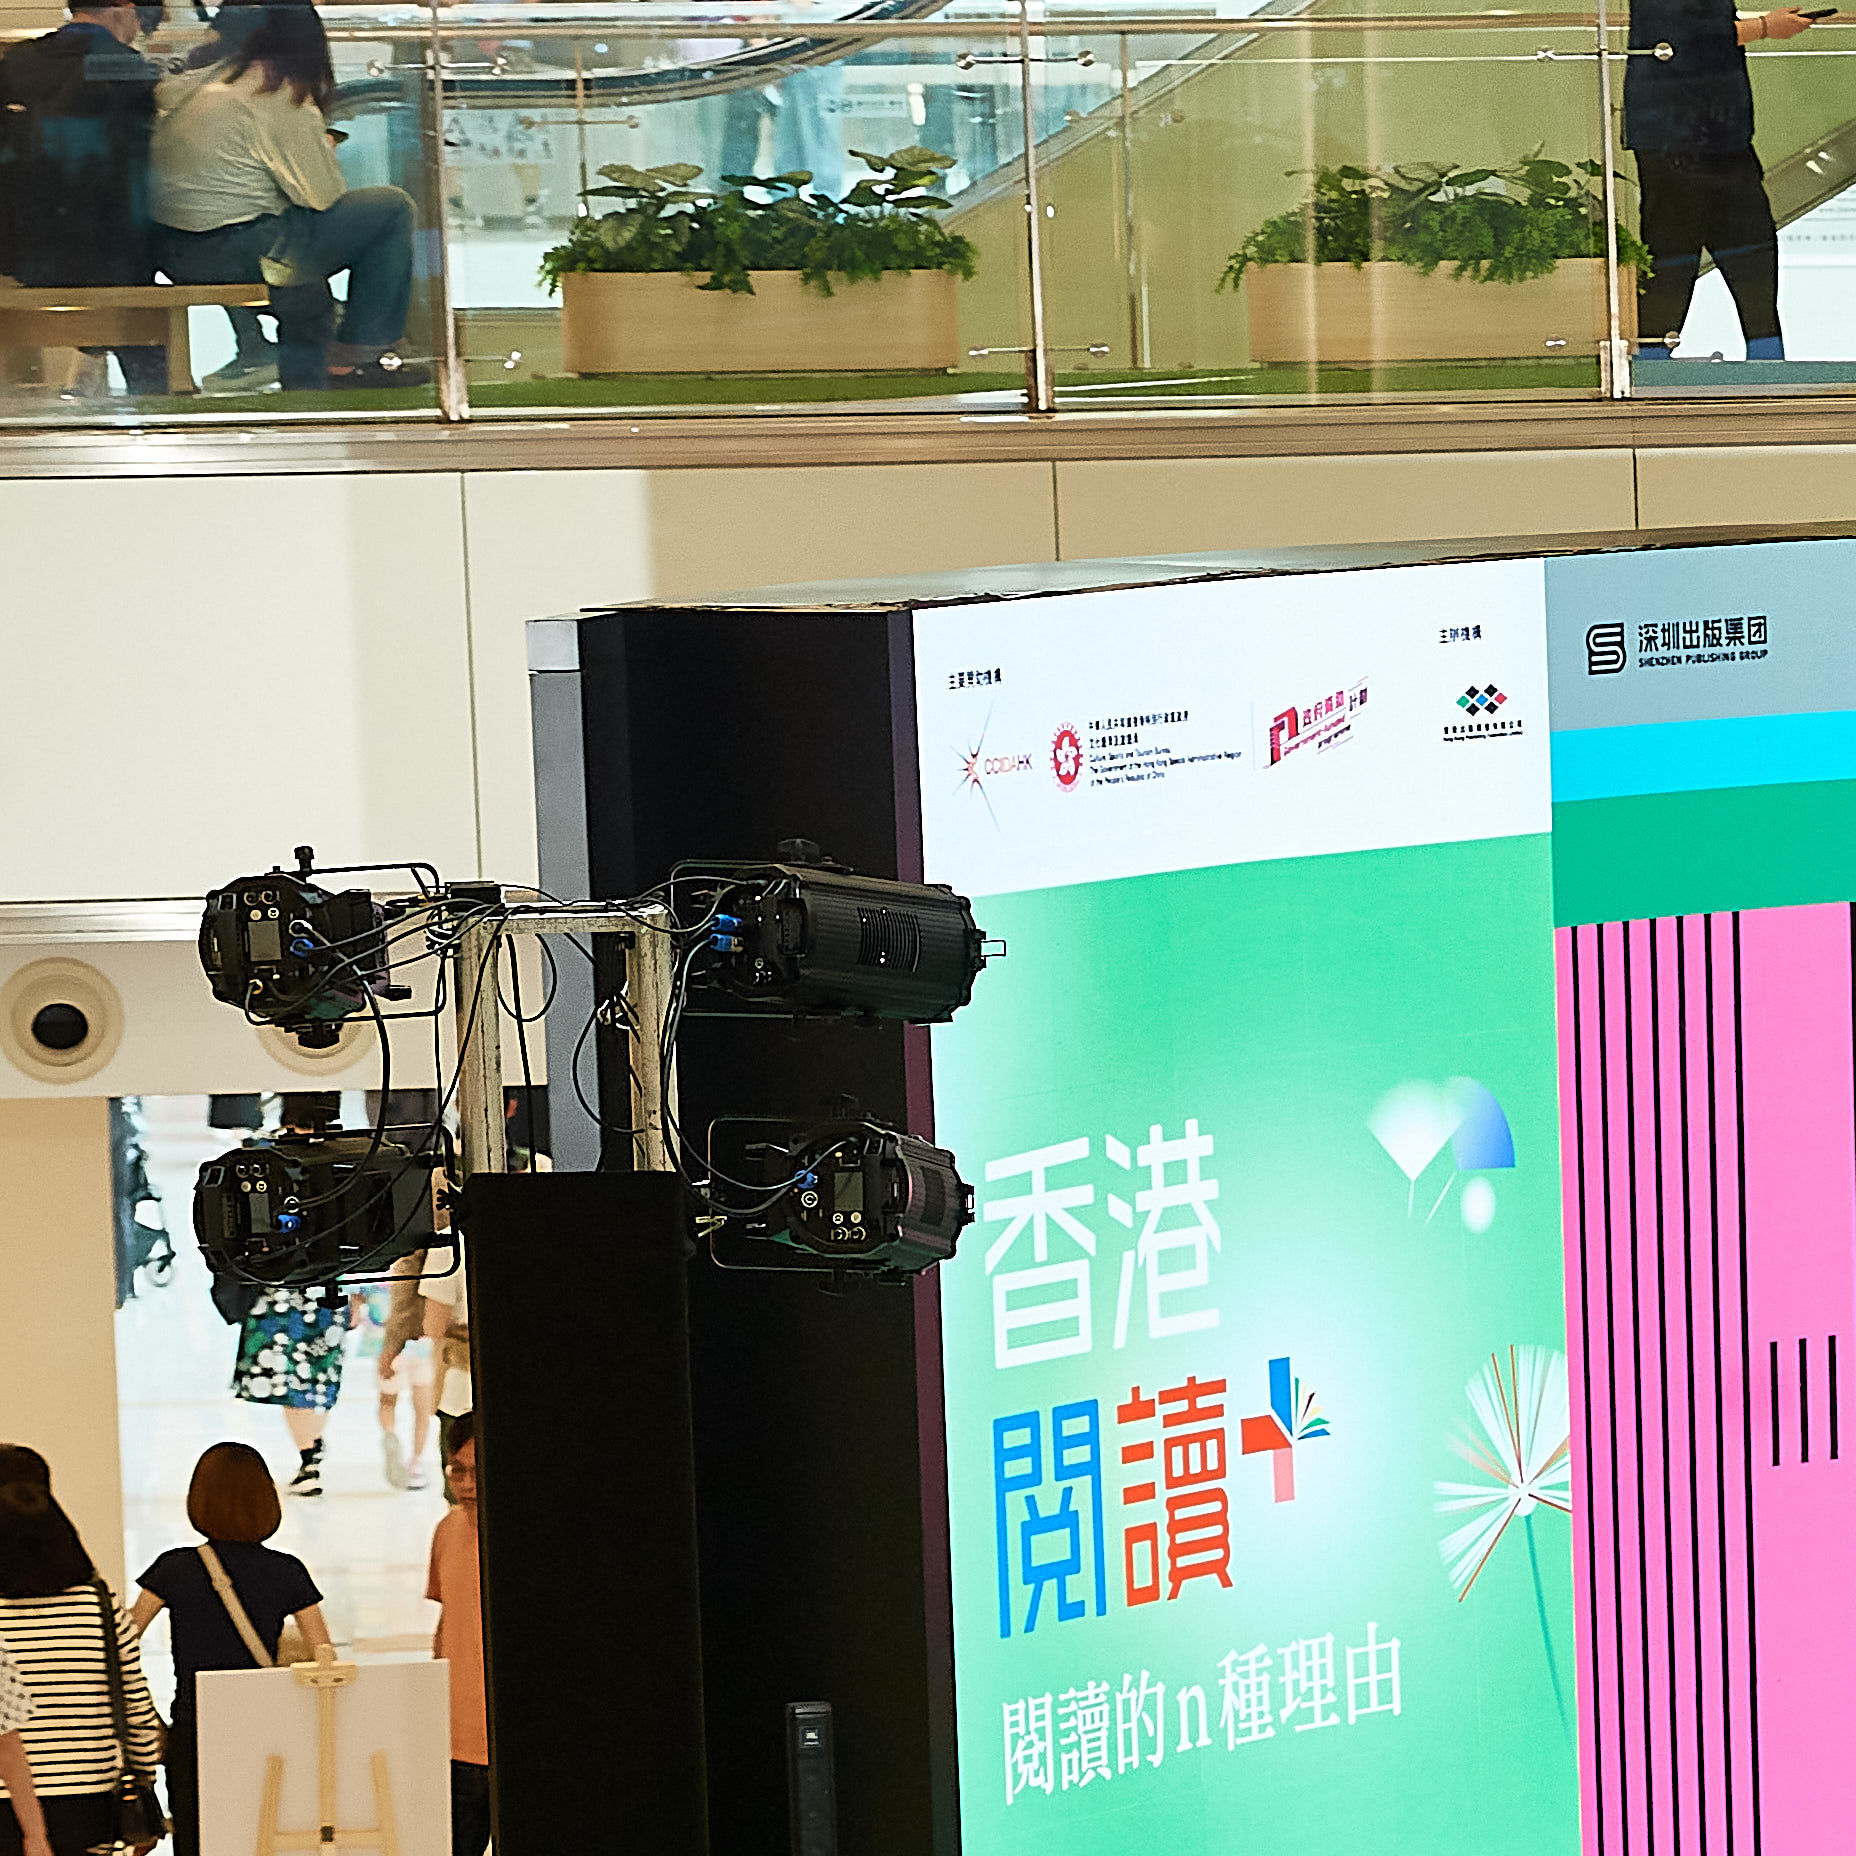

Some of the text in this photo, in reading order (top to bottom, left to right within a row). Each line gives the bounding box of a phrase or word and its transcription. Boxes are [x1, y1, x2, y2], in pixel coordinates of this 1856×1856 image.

[1637, 616, 1768, 653] 深圳出版集团
[983, 1117, 1222, 1370] 香港
[1001, 1620, 1403, 1807] 閱讀的n種理由
